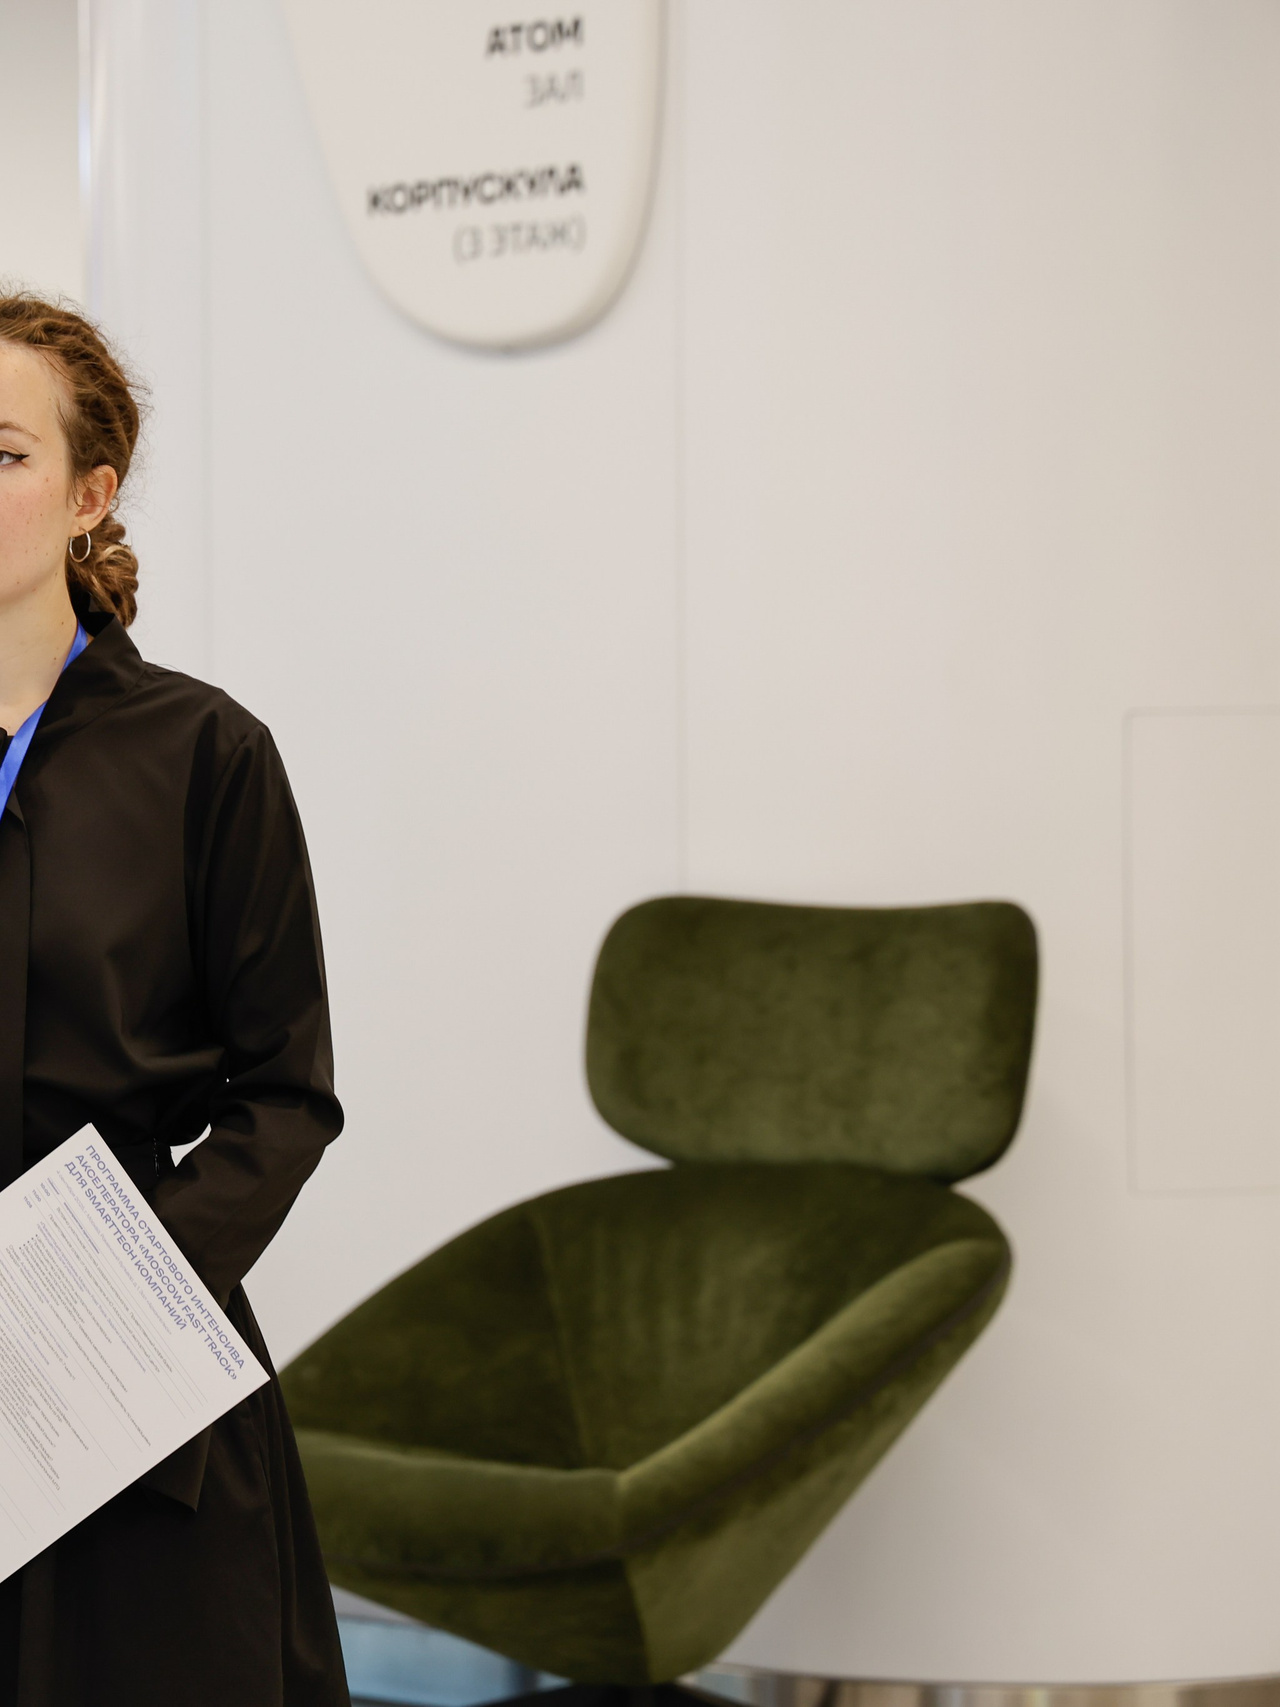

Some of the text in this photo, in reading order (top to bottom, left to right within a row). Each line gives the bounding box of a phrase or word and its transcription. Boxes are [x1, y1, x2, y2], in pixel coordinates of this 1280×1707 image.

[485, 17, 585, 58] АТОМ
[525, 70, 585, 107] ЗАЛ
[367, 163, 586, 217] КОРПУСКУЛА
[63, 1160, 87, 1189] ДЛЯ
[83, 1187, 138, 1261] SMARTTECH
[133, 1257, 188, 1330] КОМПАНИЙ
[74, 1152, 142, 1244] АКСЕЛЕРАТОРА
[137, 1241, 185, 1306] «MOSCOW
[180, 1303, 207, 1336] FAST
[201, 1333, 239, 1381] TRACK»
[84, 1144, 141, 1220] ПРОГРАММА
[136, 1217, 194, 1296] СТАРТОВОГО
[190, 1293, 246, 1369] ИНТЕНСИВА
